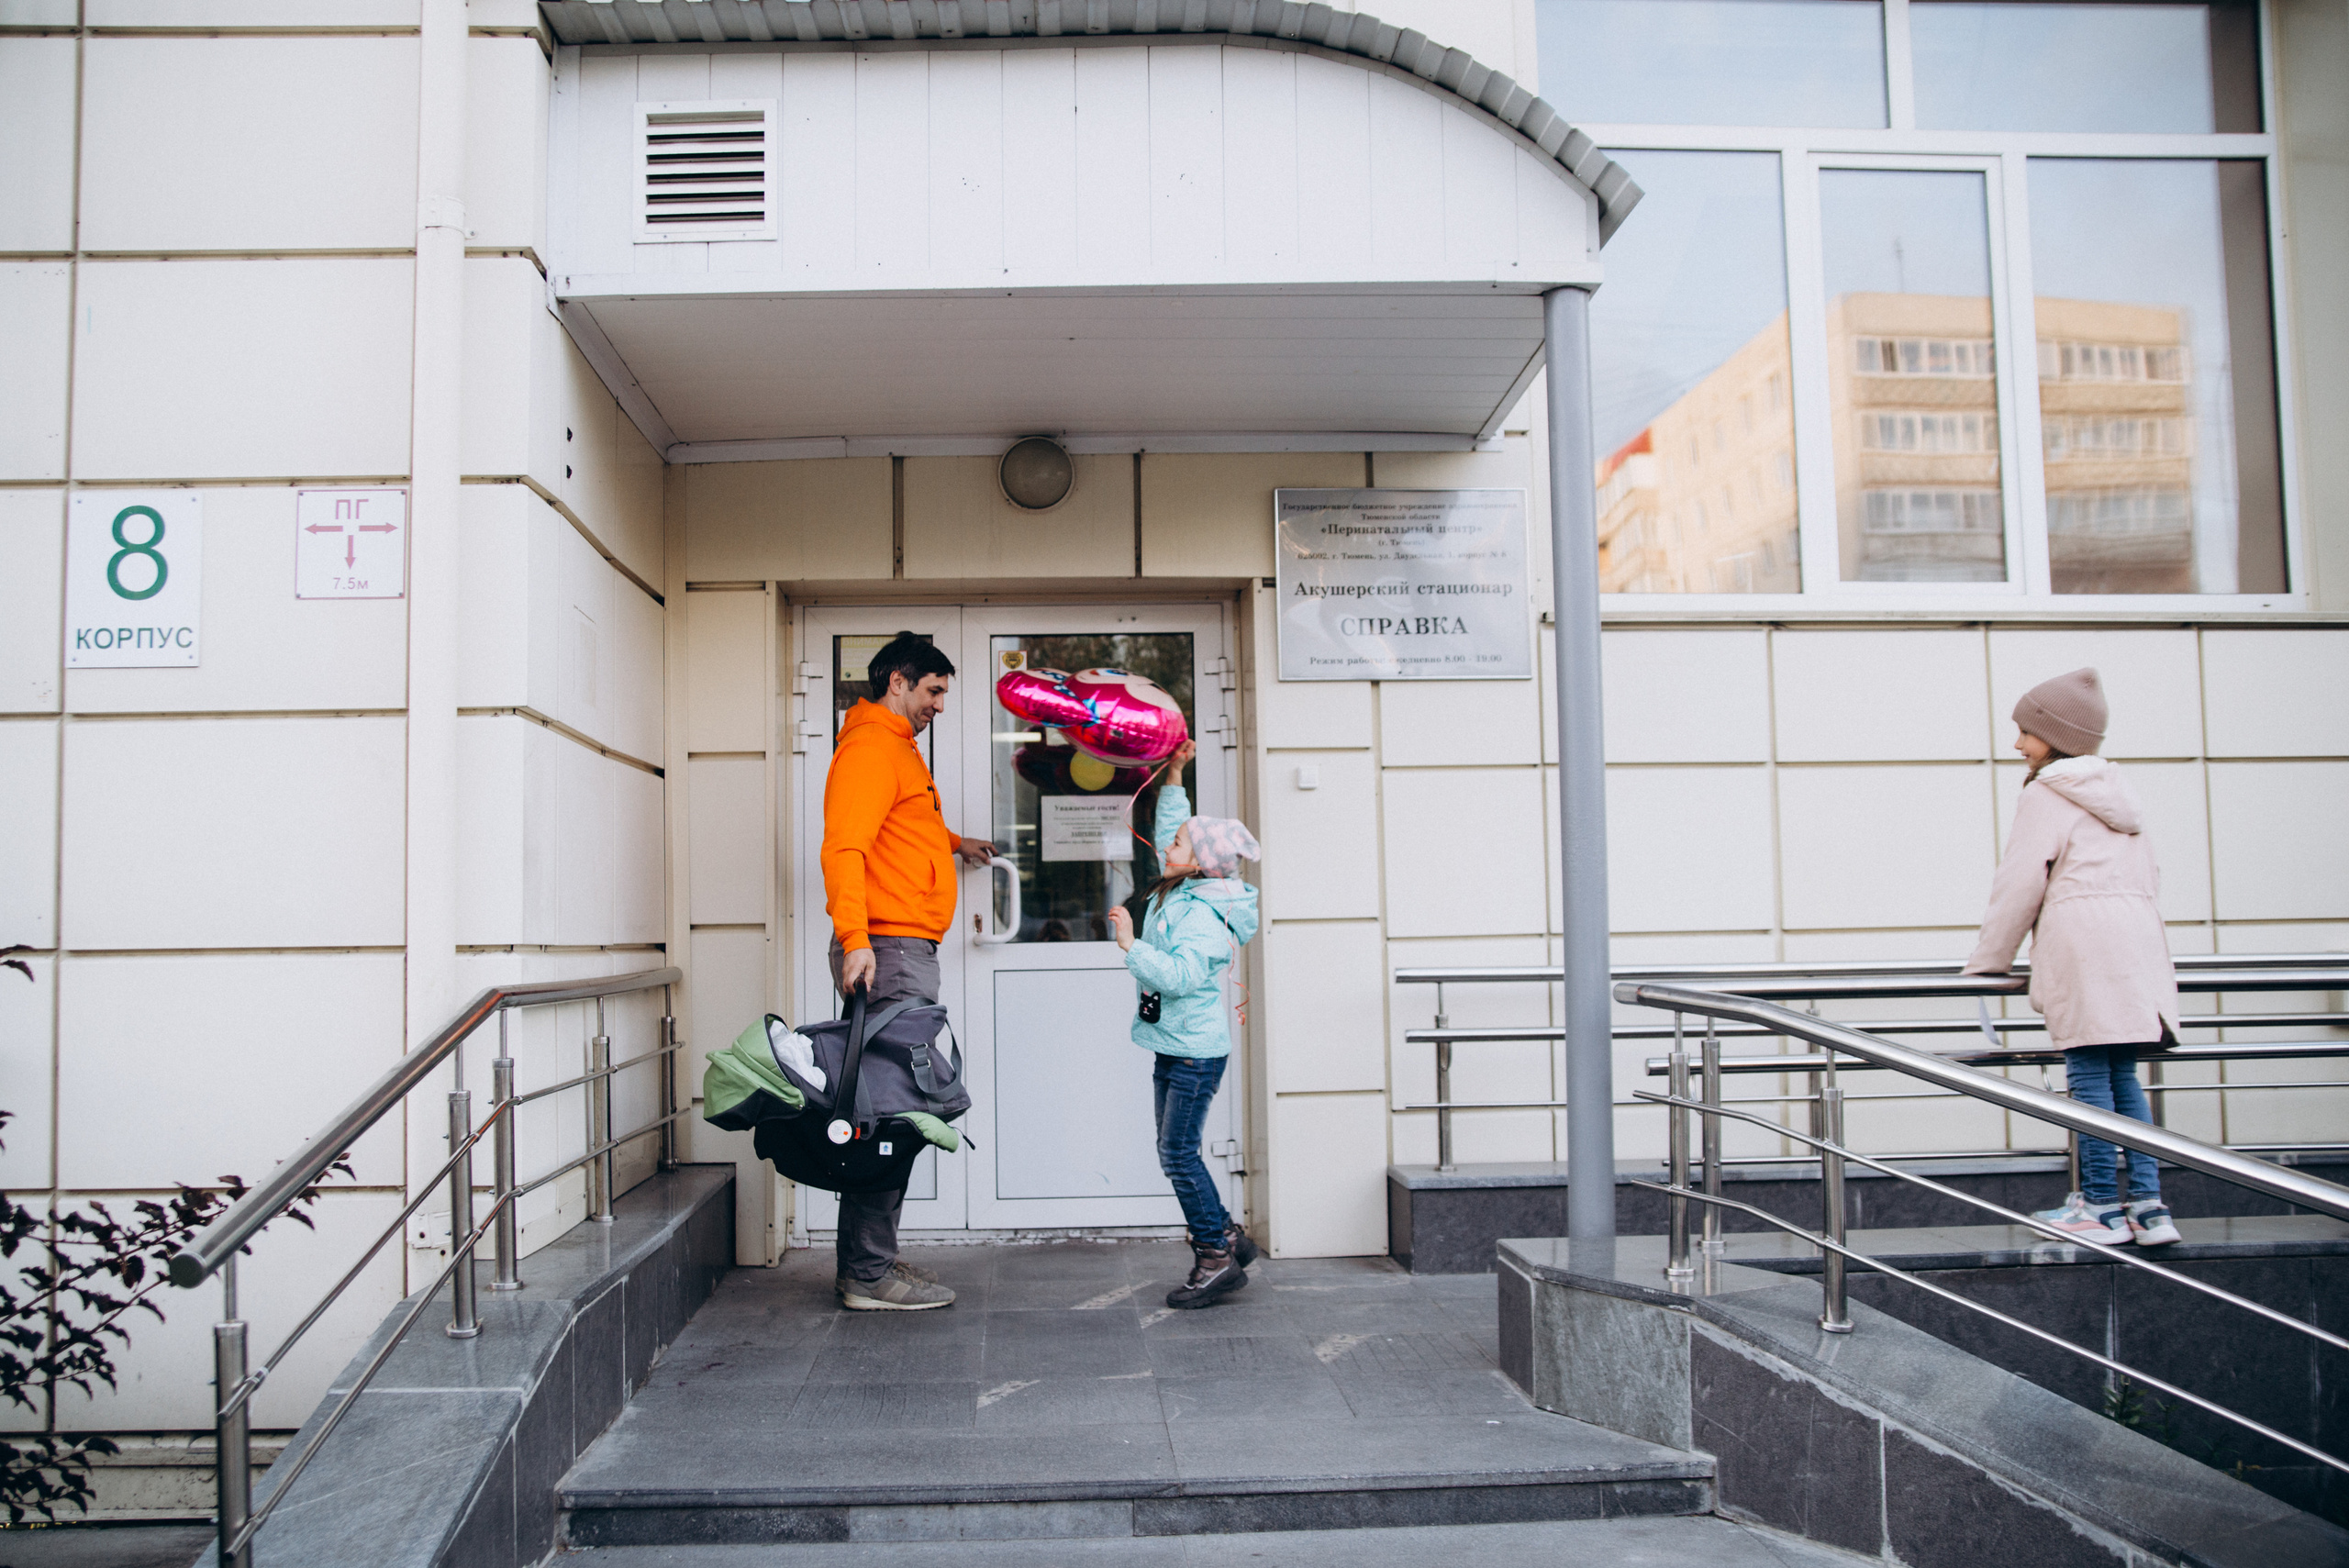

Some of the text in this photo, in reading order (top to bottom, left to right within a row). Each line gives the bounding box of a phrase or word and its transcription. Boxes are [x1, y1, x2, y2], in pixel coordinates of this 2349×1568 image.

[335, 499, 369, 520] ПГ
[1352, 503, 1397, 511] бюджетное
[1321, 523, 1433, 536] «Перинатальный
[106, 505, 168, 601] 8
[1294, 581, 1513, 598] Акушерский стационар
[1341, 616, 1468, 636] СПРАВКА
[76, 627, 194, 650] КОРПУС
[1310, 656, 1343, 665] Режим
[1444, 654, 1466, 663] 8.00
